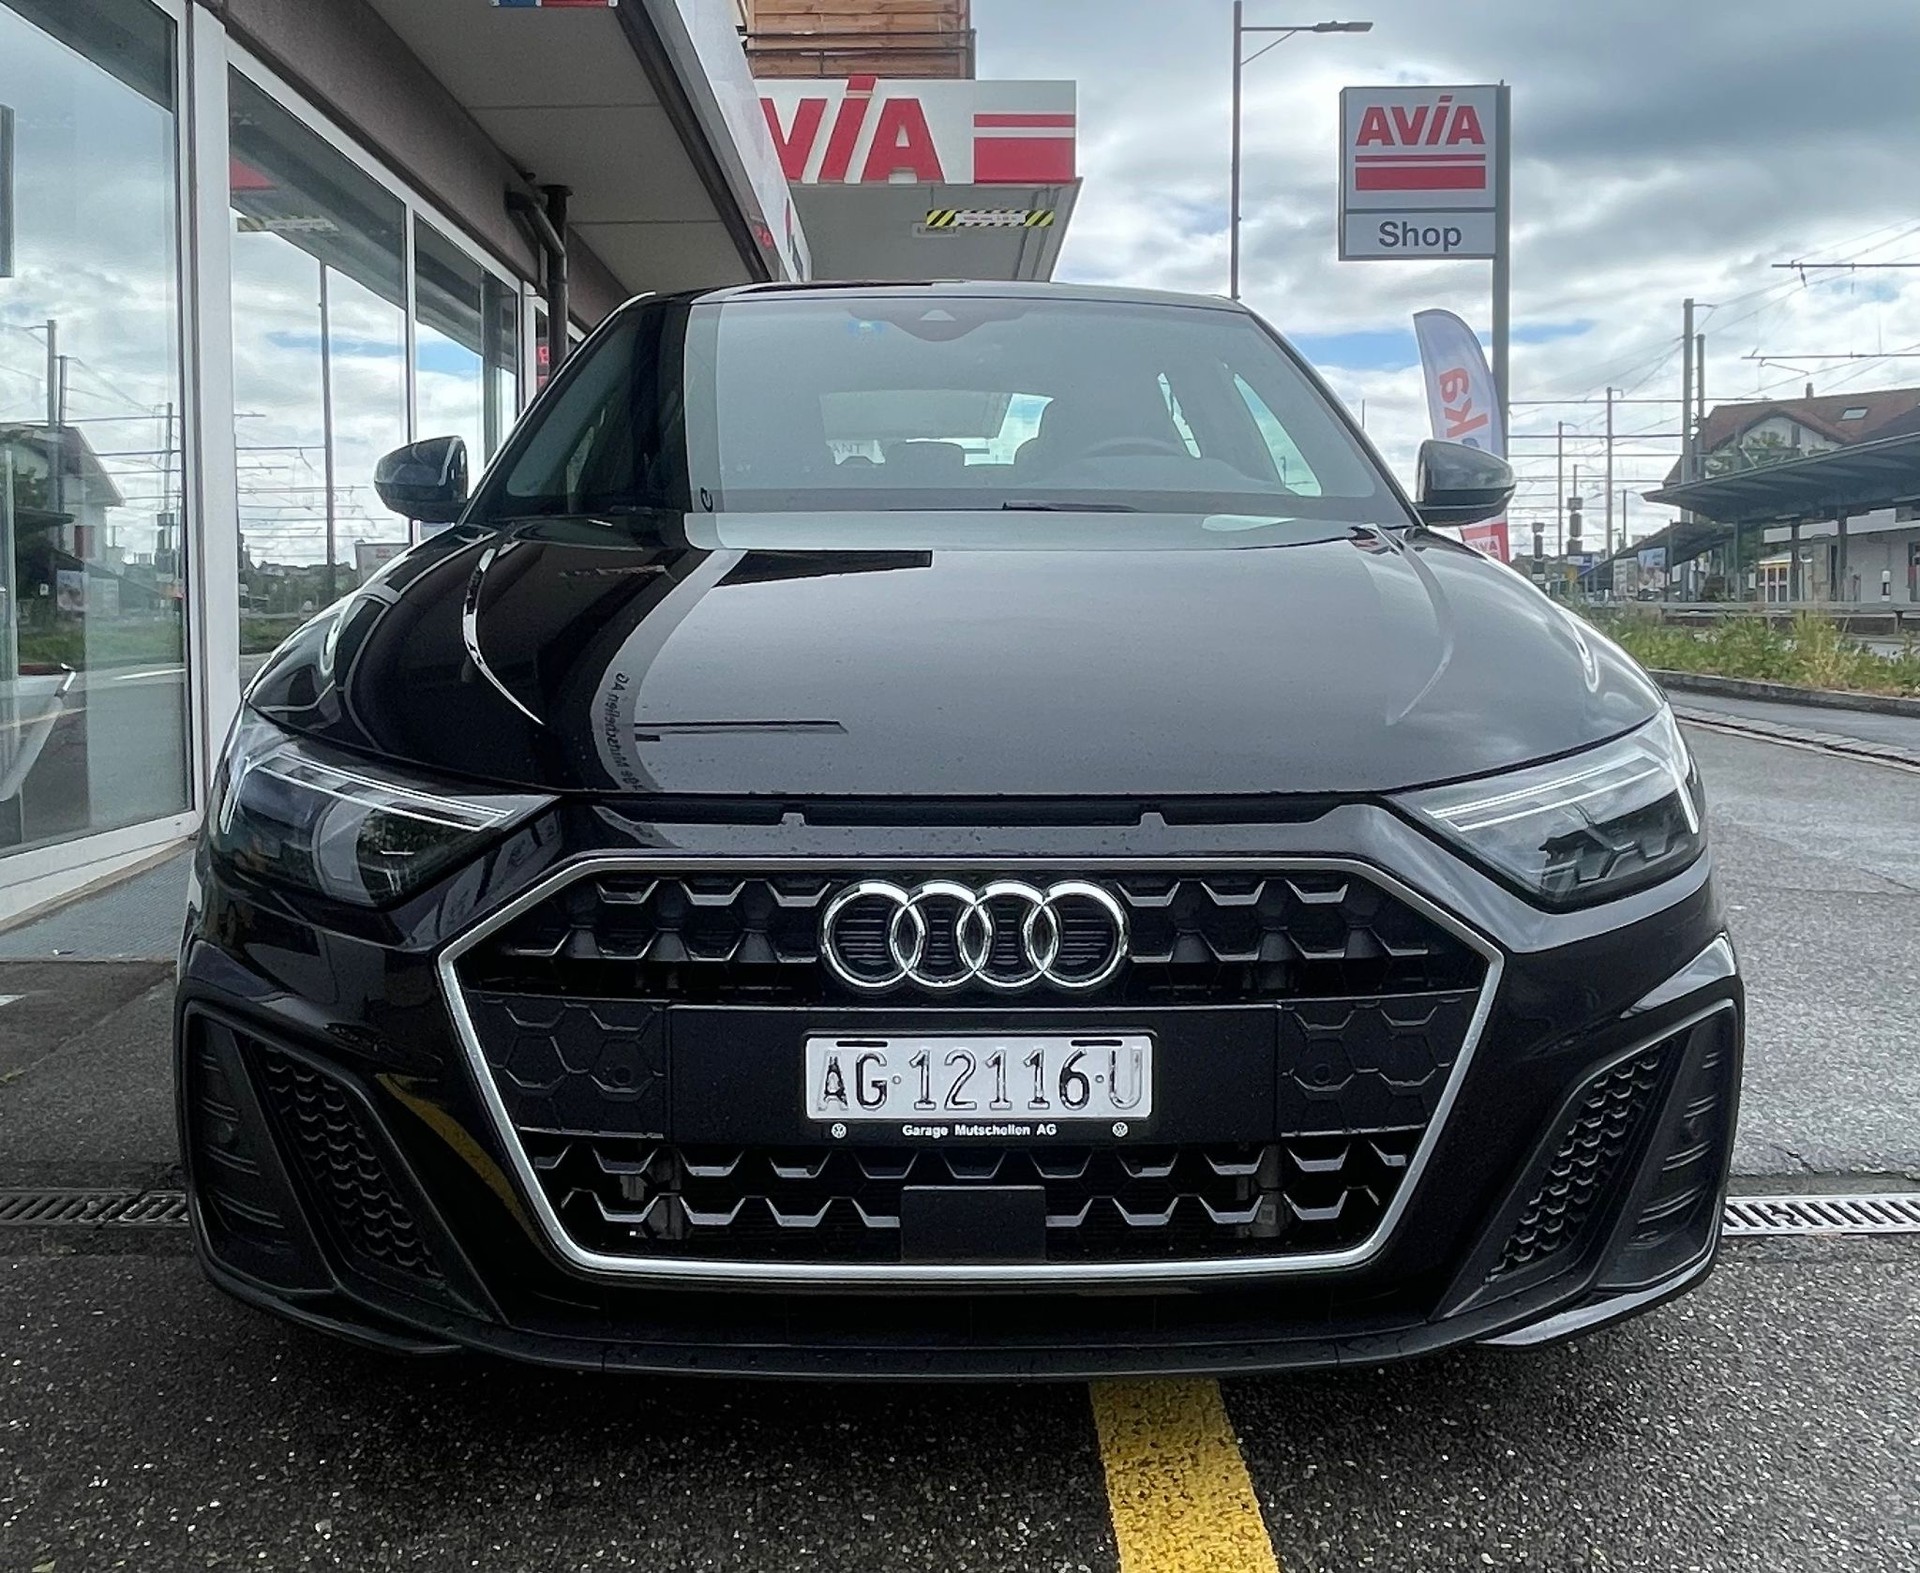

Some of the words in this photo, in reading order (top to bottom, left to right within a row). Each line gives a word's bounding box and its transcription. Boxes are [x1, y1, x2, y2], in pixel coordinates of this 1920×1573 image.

[759, 75, 945, 184] VIA
[1355, 94, 1486, 146] AVIA
[1378, 220, 1463, 252] Shop
[902, 1124, 949, 1139] Garage
[1036, 1123, 1058, 1136] AG
